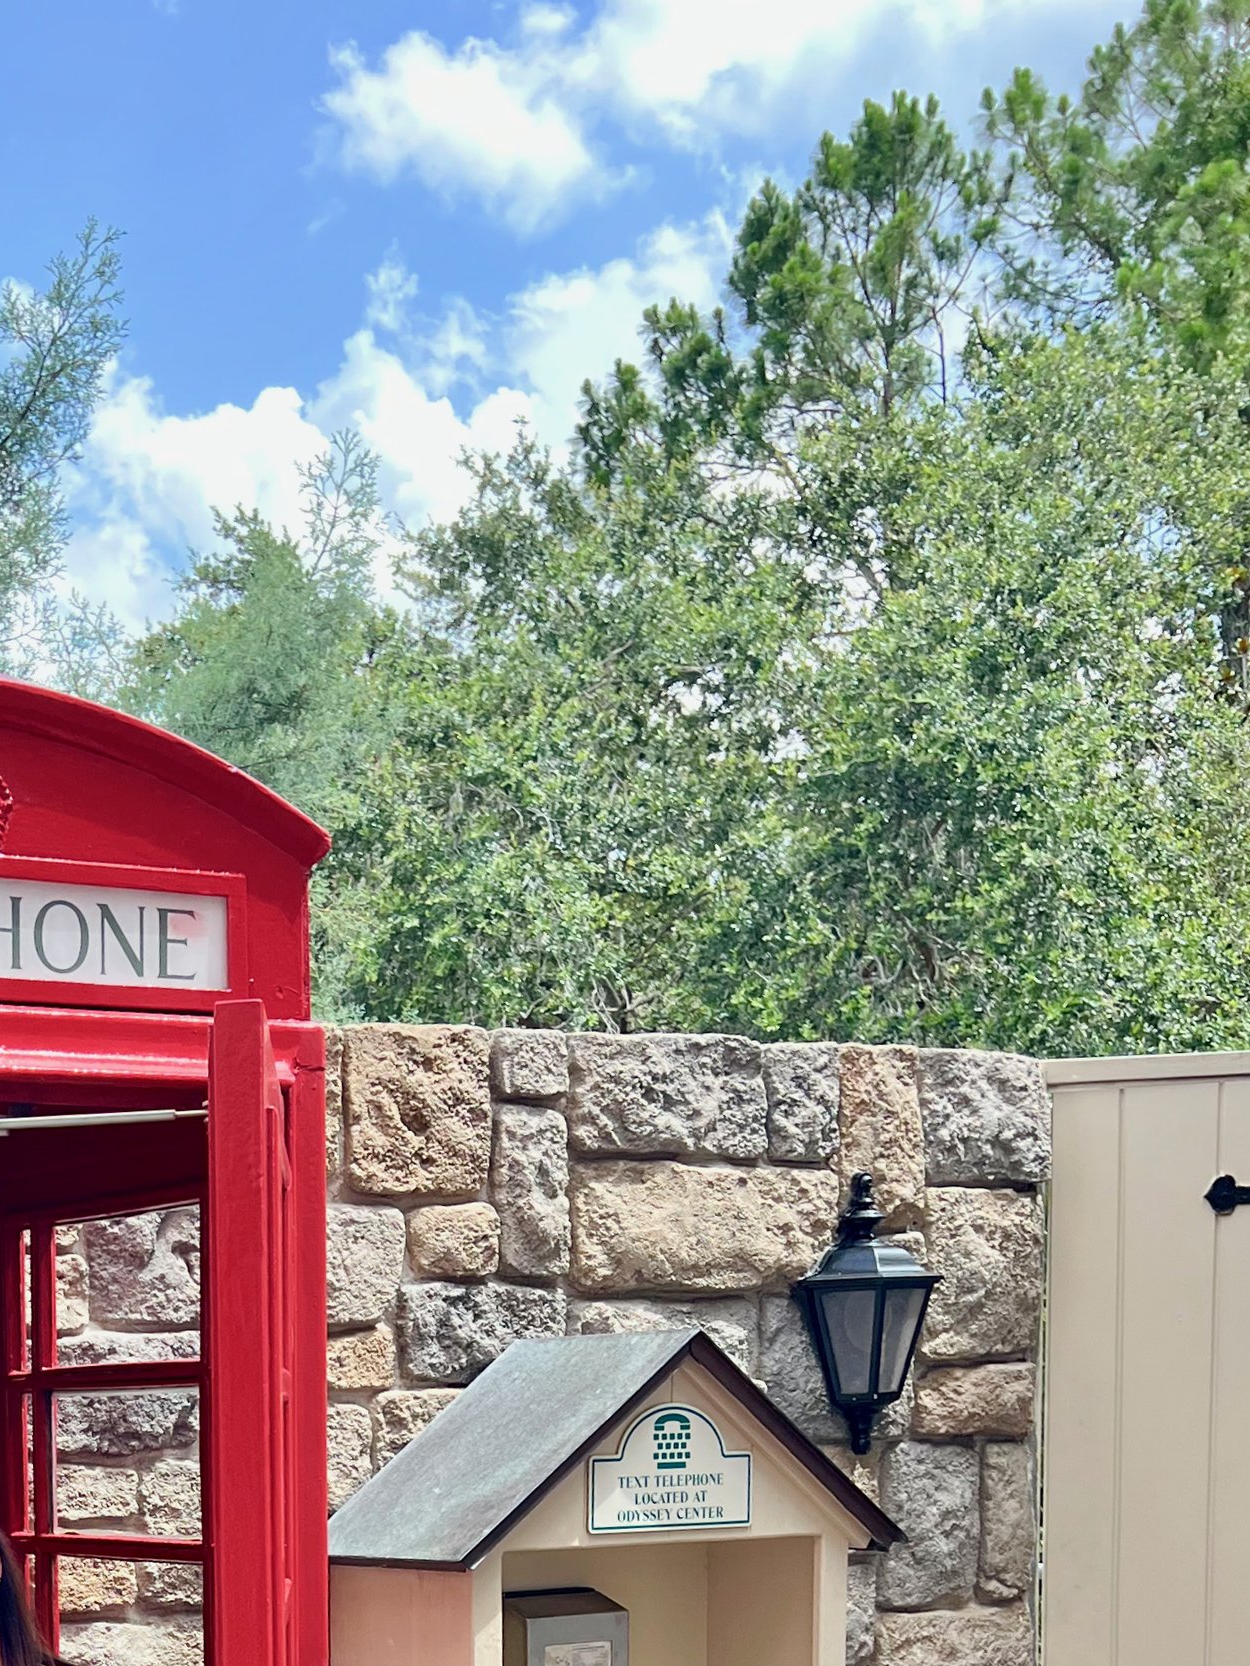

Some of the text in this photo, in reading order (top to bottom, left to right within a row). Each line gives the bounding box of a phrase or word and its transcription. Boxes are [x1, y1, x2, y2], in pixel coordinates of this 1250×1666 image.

[617, 1473, 724, 1489] TEXT TELEPHONE
[634, 1490, 708, 1505] LOCATED AT
[617, 1506, 724, 1522] ODYSSEY CENTER
